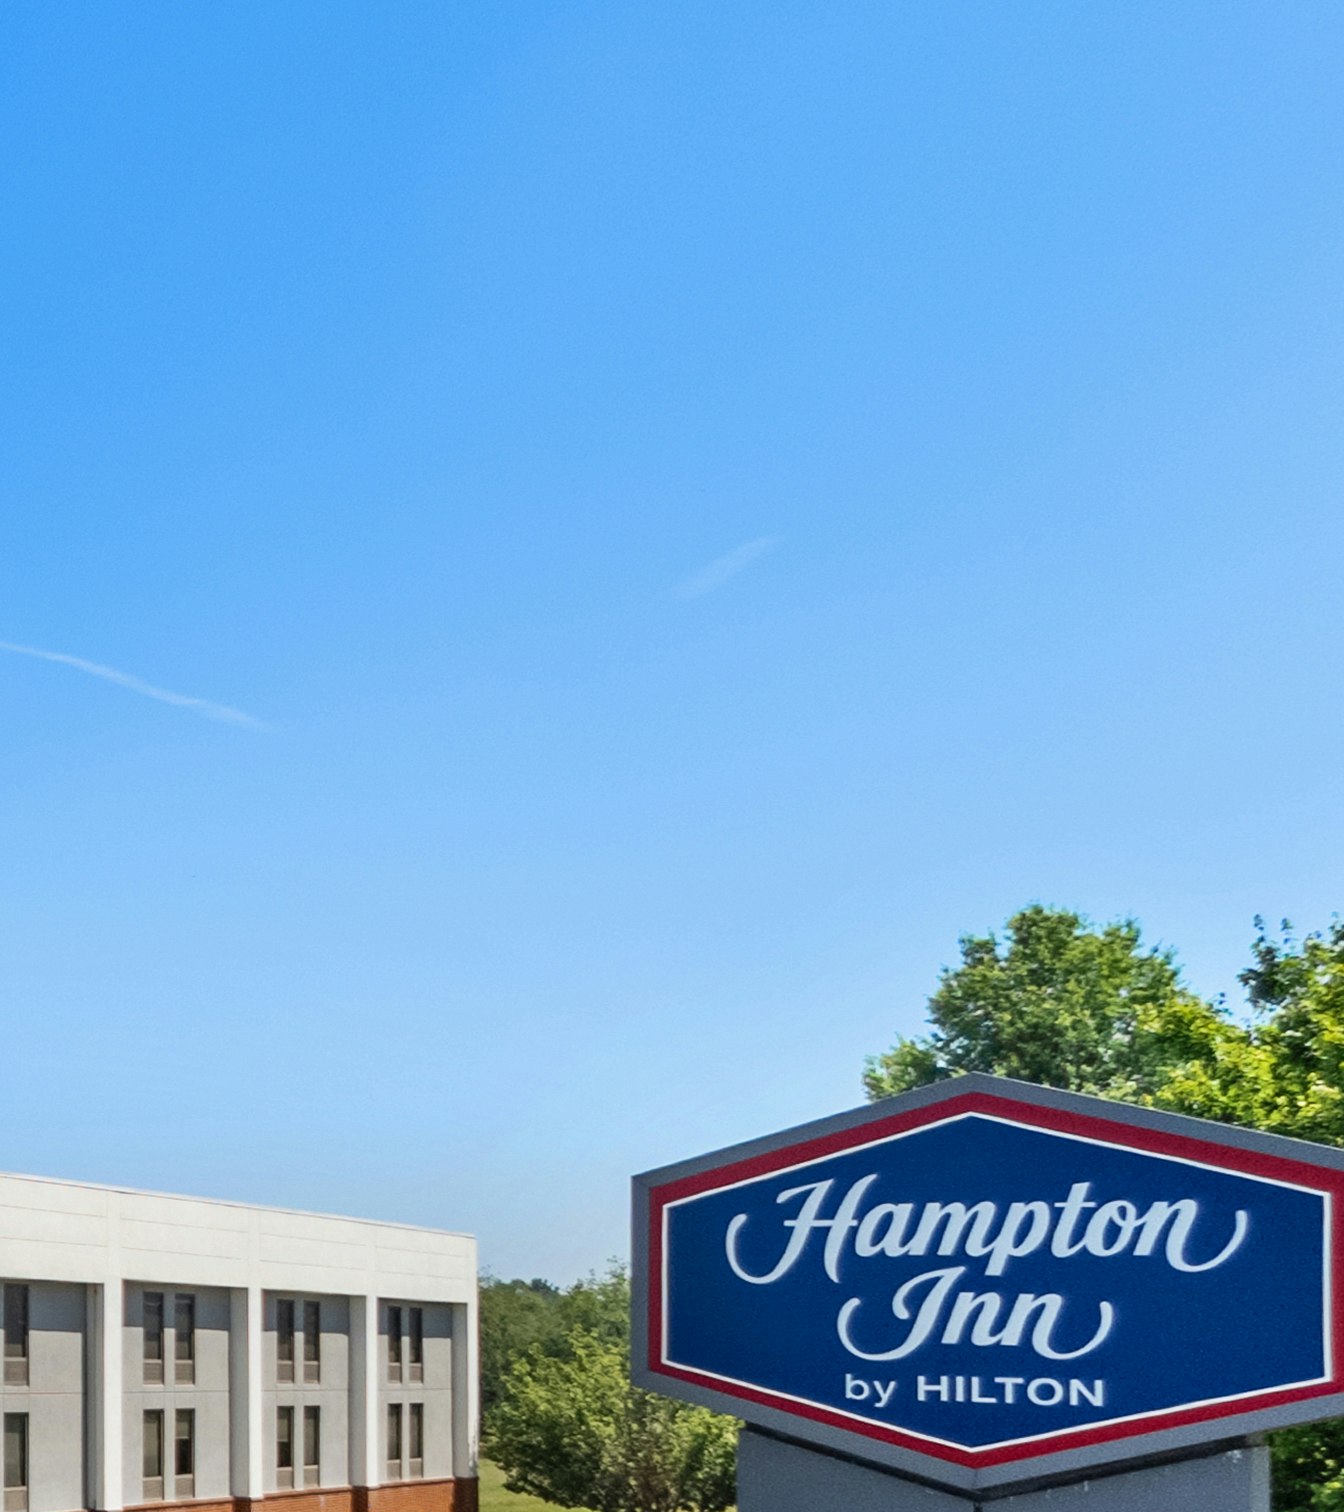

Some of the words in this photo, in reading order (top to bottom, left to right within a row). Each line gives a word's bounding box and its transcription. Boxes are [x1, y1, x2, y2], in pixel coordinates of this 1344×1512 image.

[725, 1173, 1249, 1284] Hampton
[836, 1265, 1113, 1361] Inn
[844, 1373, 897, 1408] by
[916, 1374, 1104, 1407] HILTON
